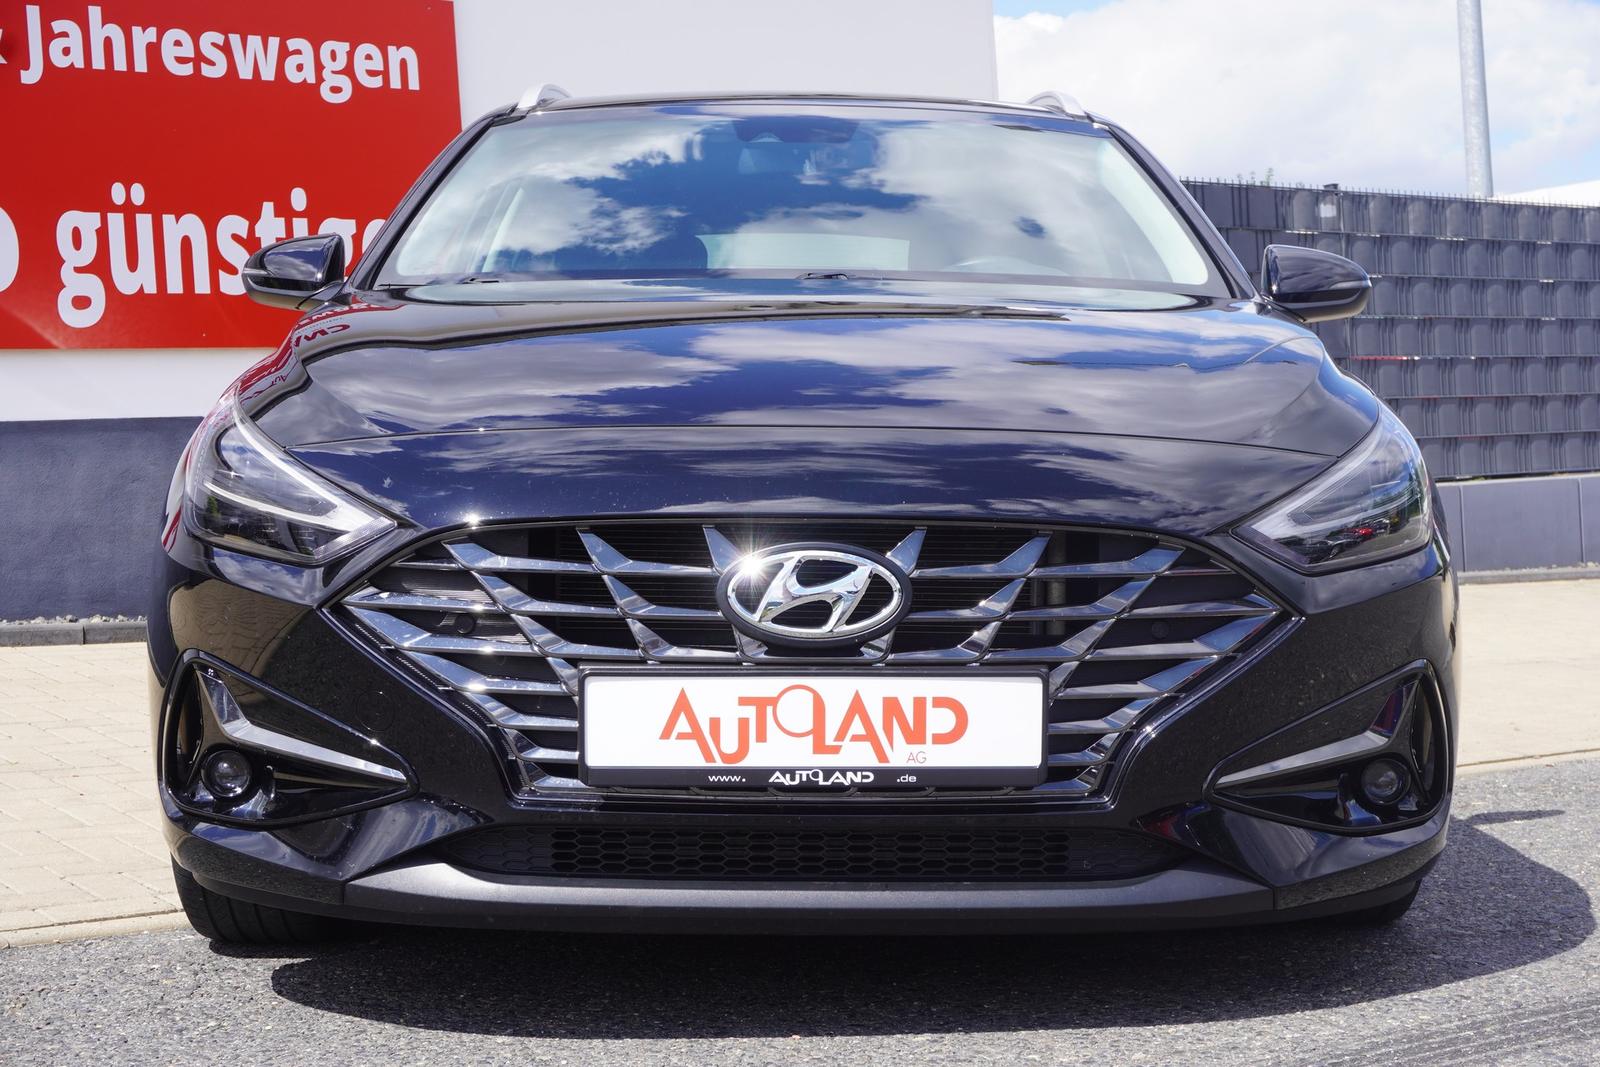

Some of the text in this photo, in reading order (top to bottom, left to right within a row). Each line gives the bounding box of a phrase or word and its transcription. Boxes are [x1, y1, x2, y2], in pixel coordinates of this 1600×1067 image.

[20, 4, 420, 104] Jahreswagen
[906, 751, 927, 765] AG
[708, 774, 746, 783] www.
[896, 774, 917, 783] .de
